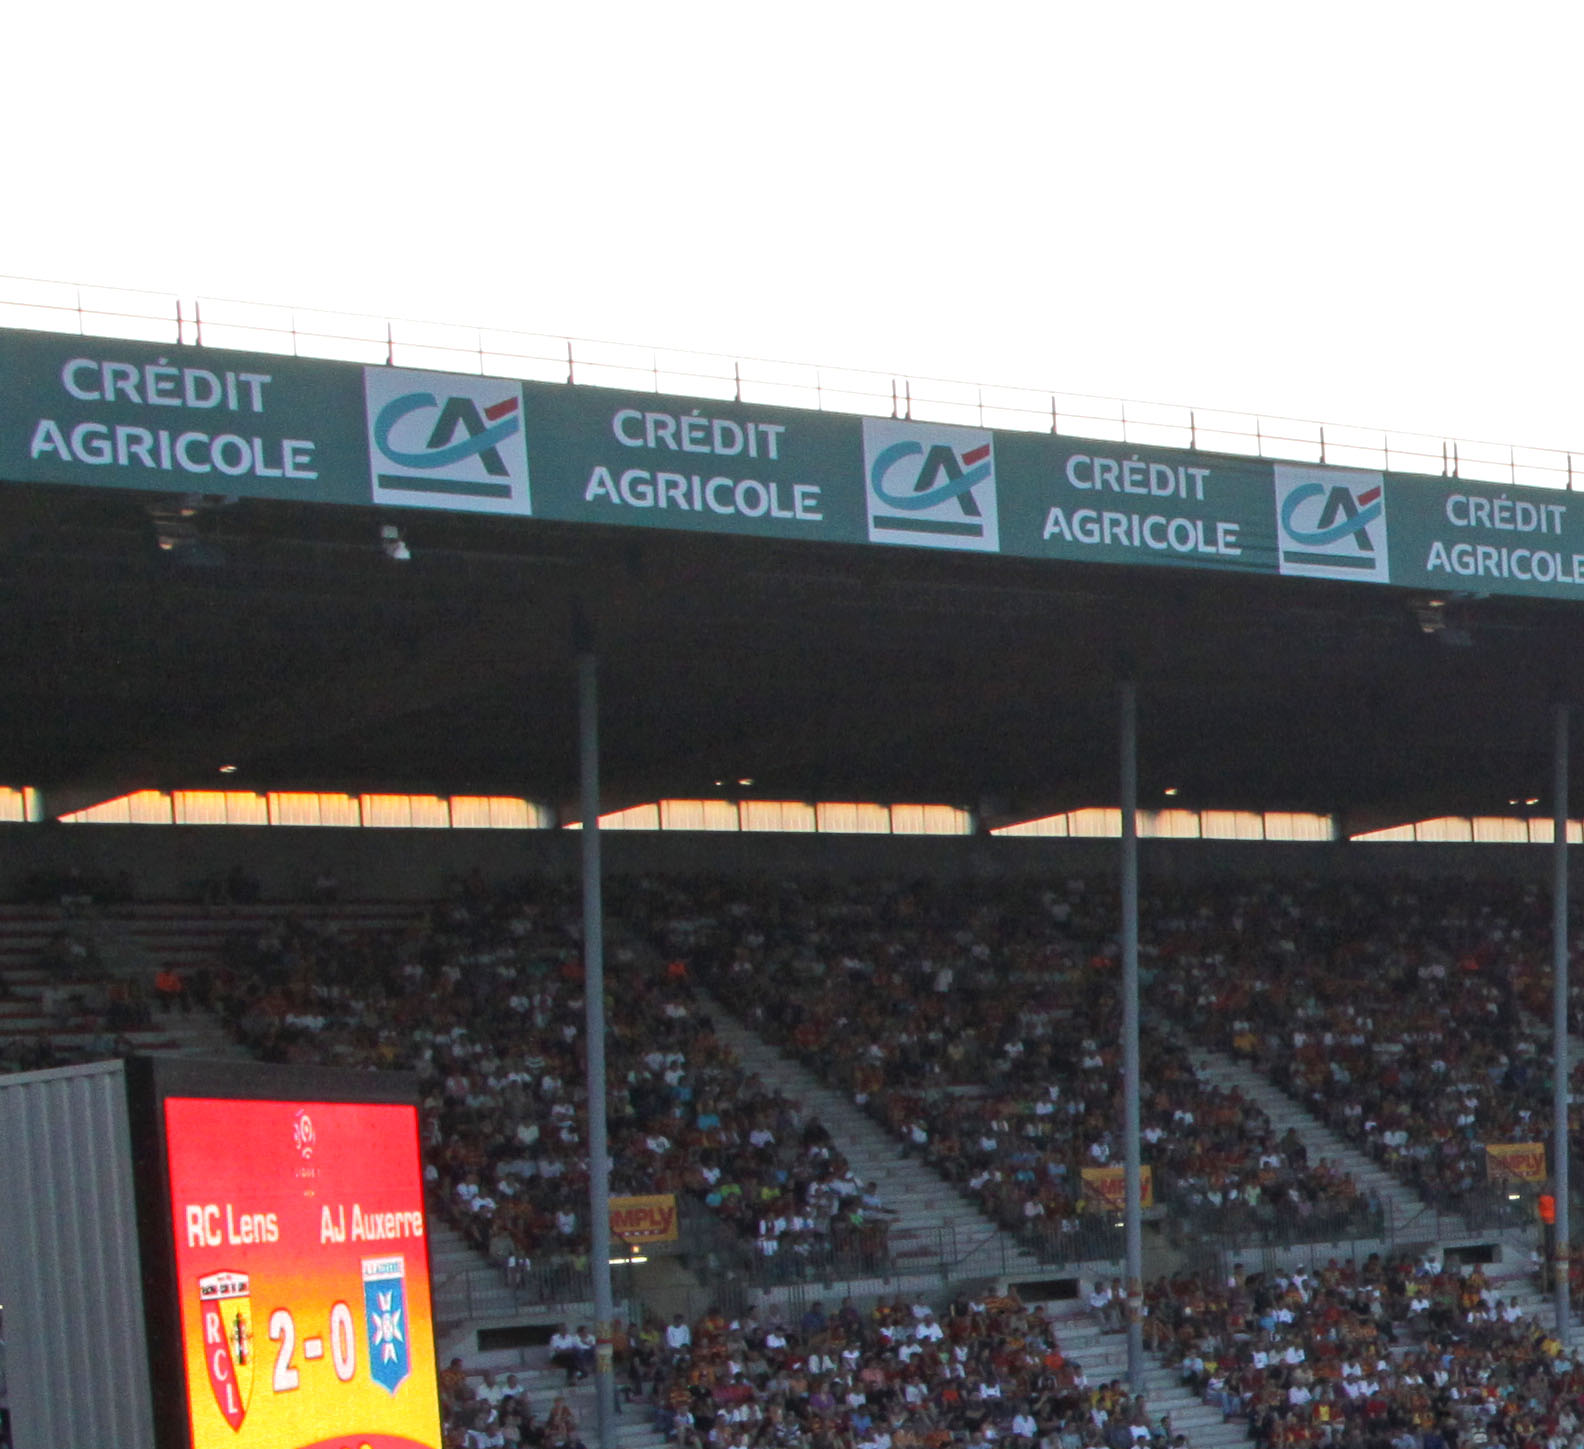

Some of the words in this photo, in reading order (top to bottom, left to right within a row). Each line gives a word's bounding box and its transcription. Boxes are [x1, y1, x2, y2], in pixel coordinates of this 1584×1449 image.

[61, 356, 272, 412] CRÉDIT
[31, 418, 318, 480] AGRICOLE
[612, 408, 786, 460] CRÉDIT
[585, 465, 823, 521] AGRICOLE
[1066, 452, 1210, 501] CRÉDIT
[1042, 507, 1243, 555] AGRICOLE
[1445, 493, 1567, 537] CRÉDIT
[186, 1204, 221, 1248] RC
[227, 1206, 279, 1246] Lens
[320, 1204, 345, 1245] AJ
[351, 1202, 424, 1242] Auxerre
